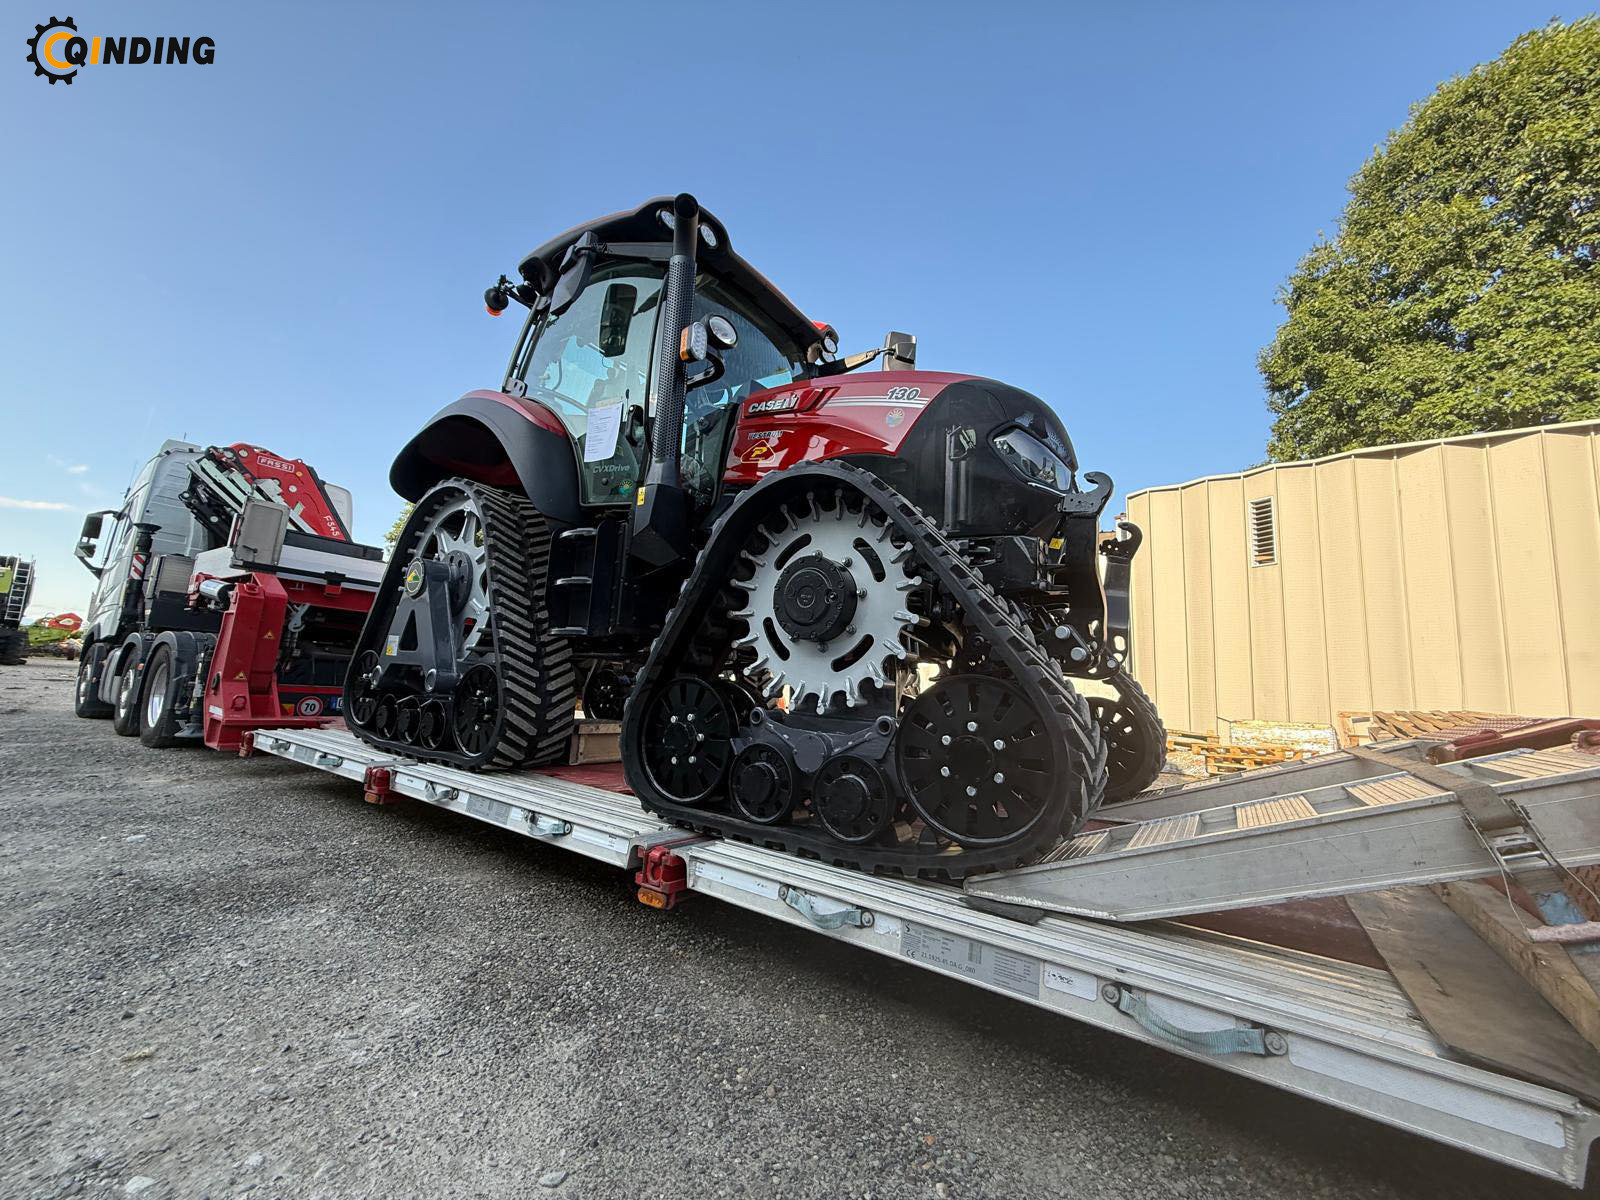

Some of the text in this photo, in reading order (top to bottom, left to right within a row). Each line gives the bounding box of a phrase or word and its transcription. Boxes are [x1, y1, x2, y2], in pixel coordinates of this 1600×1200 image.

[887, 386, 920, 401] 130
[260, 457, 292, 471] FASSI
[592, 464, 631, 475] CVXDrive
[323, 515, 340, 537] F545
[304, 702, 316, 712] 70
